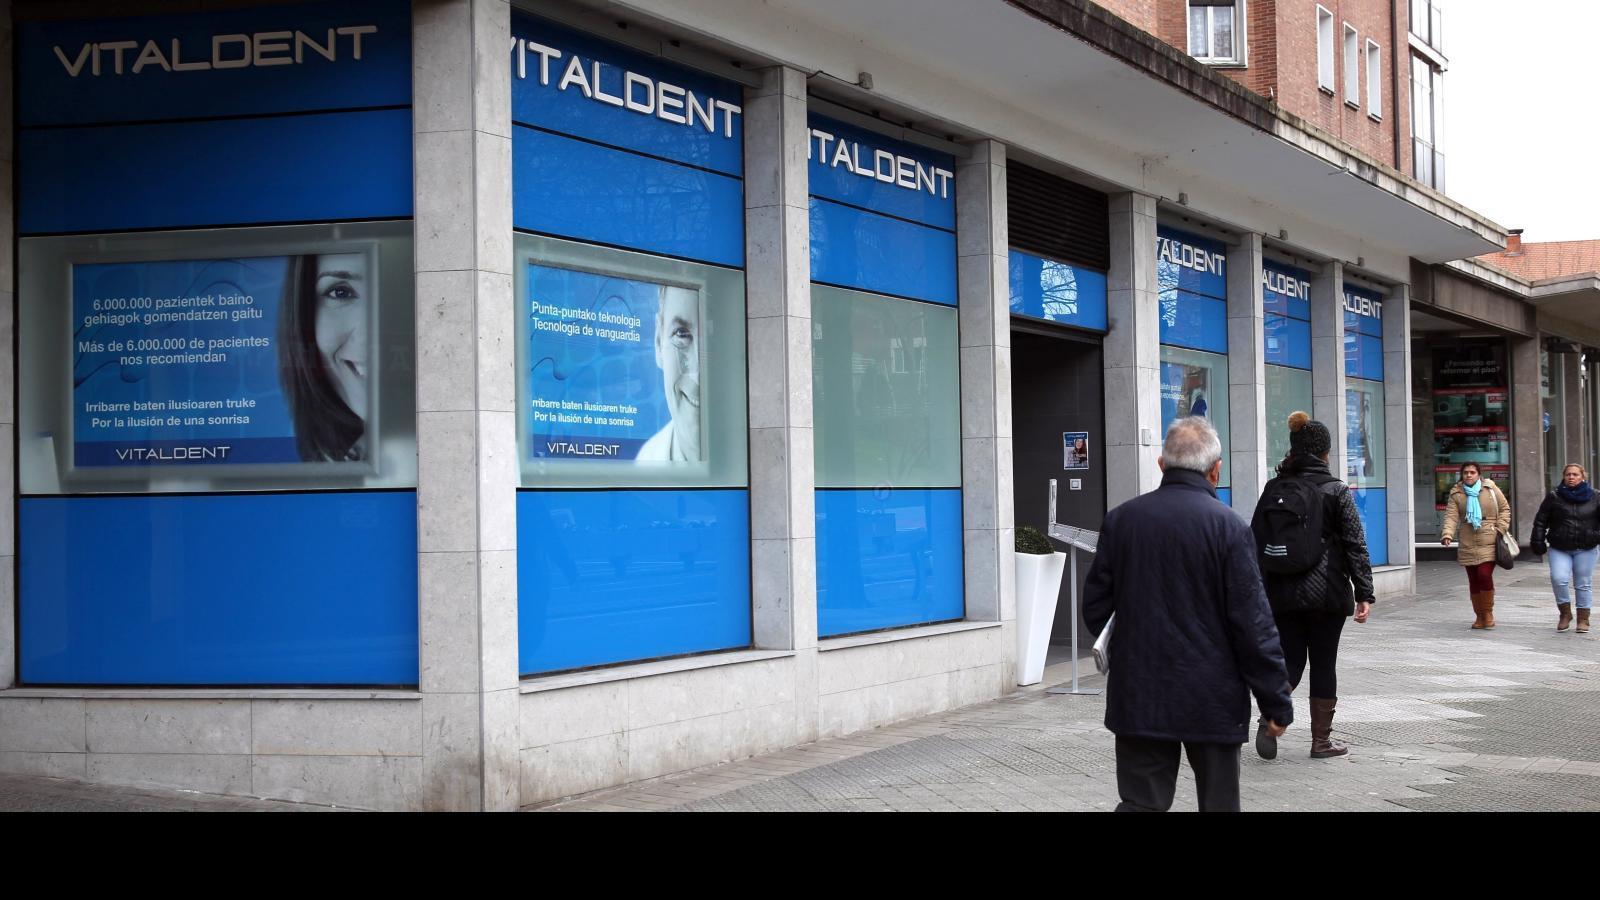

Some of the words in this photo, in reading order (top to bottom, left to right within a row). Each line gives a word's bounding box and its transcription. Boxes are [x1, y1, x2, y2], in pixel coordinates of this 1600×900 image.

[53, 25, 378, 77] VITALDENT
[510, 36, 742, 138] ITALDENT
[807, 127, 954, 199] ITALDENT
[1262, 268, 1311, 302] ALDENT
[93, 297, 151, 310] 6.000.000
[155, 295, 215, 310] pazientek
[218, 294, 253, 305] baino
[84, 312, 141, 328] gehiagok
[144, 308, 228, 325] gomendatzen
[231, 307, 263, 322] gaitu
[532, 301, 597, 321] Punta-puntako
[598, 311, 641, 329] teknologia
[532, 317, 581, 337] Tecnología
[582, 324, 594, 336] de
[595, 328, 641, 342] vanguardia
[78, 341, 105, 353] Más
[107, 340, 124, 351] de
[126, 338, 186, 351] 6.000.000
[189, 337, 205, 349] de
[208, 335, 270, 352] pacientes
[120, 355, 143, 366] nos
[146, 351, 227, 365] recomiendan
[85, 401, 131, 412] Irribarre
[133, 400, 166, 412] baten
[168, 399, 224, 411] ilusioaren
[226, 398, 257, 409] truke
[532, 398, 561, 409] rribarre
[561, 399, 583, 411] baten
[584, 401, 618, 414] ilusioaren
[619, 404, 638, 415] truke
[92, 418, 112, 428] Por
[114, 417, 125, 428] la
[127, 415, 164, 428] ilusión
[166, 415, 182, 427] de
[184, 415, 206, 426] una
[208, 414, 250, 425] sonrisa
[534, 411, 548, 422] Por
[549, 412, 557, 422] la
[558, 413, 582, 424] ilusión
[583, 415, 593, 424] de
[594, 417, 608, 426] una
[608, 418, 635, 427] sonrisa
[116, 446, 231, 461] VITALDENT
[547, 442, 620, 456] VITALDENT
